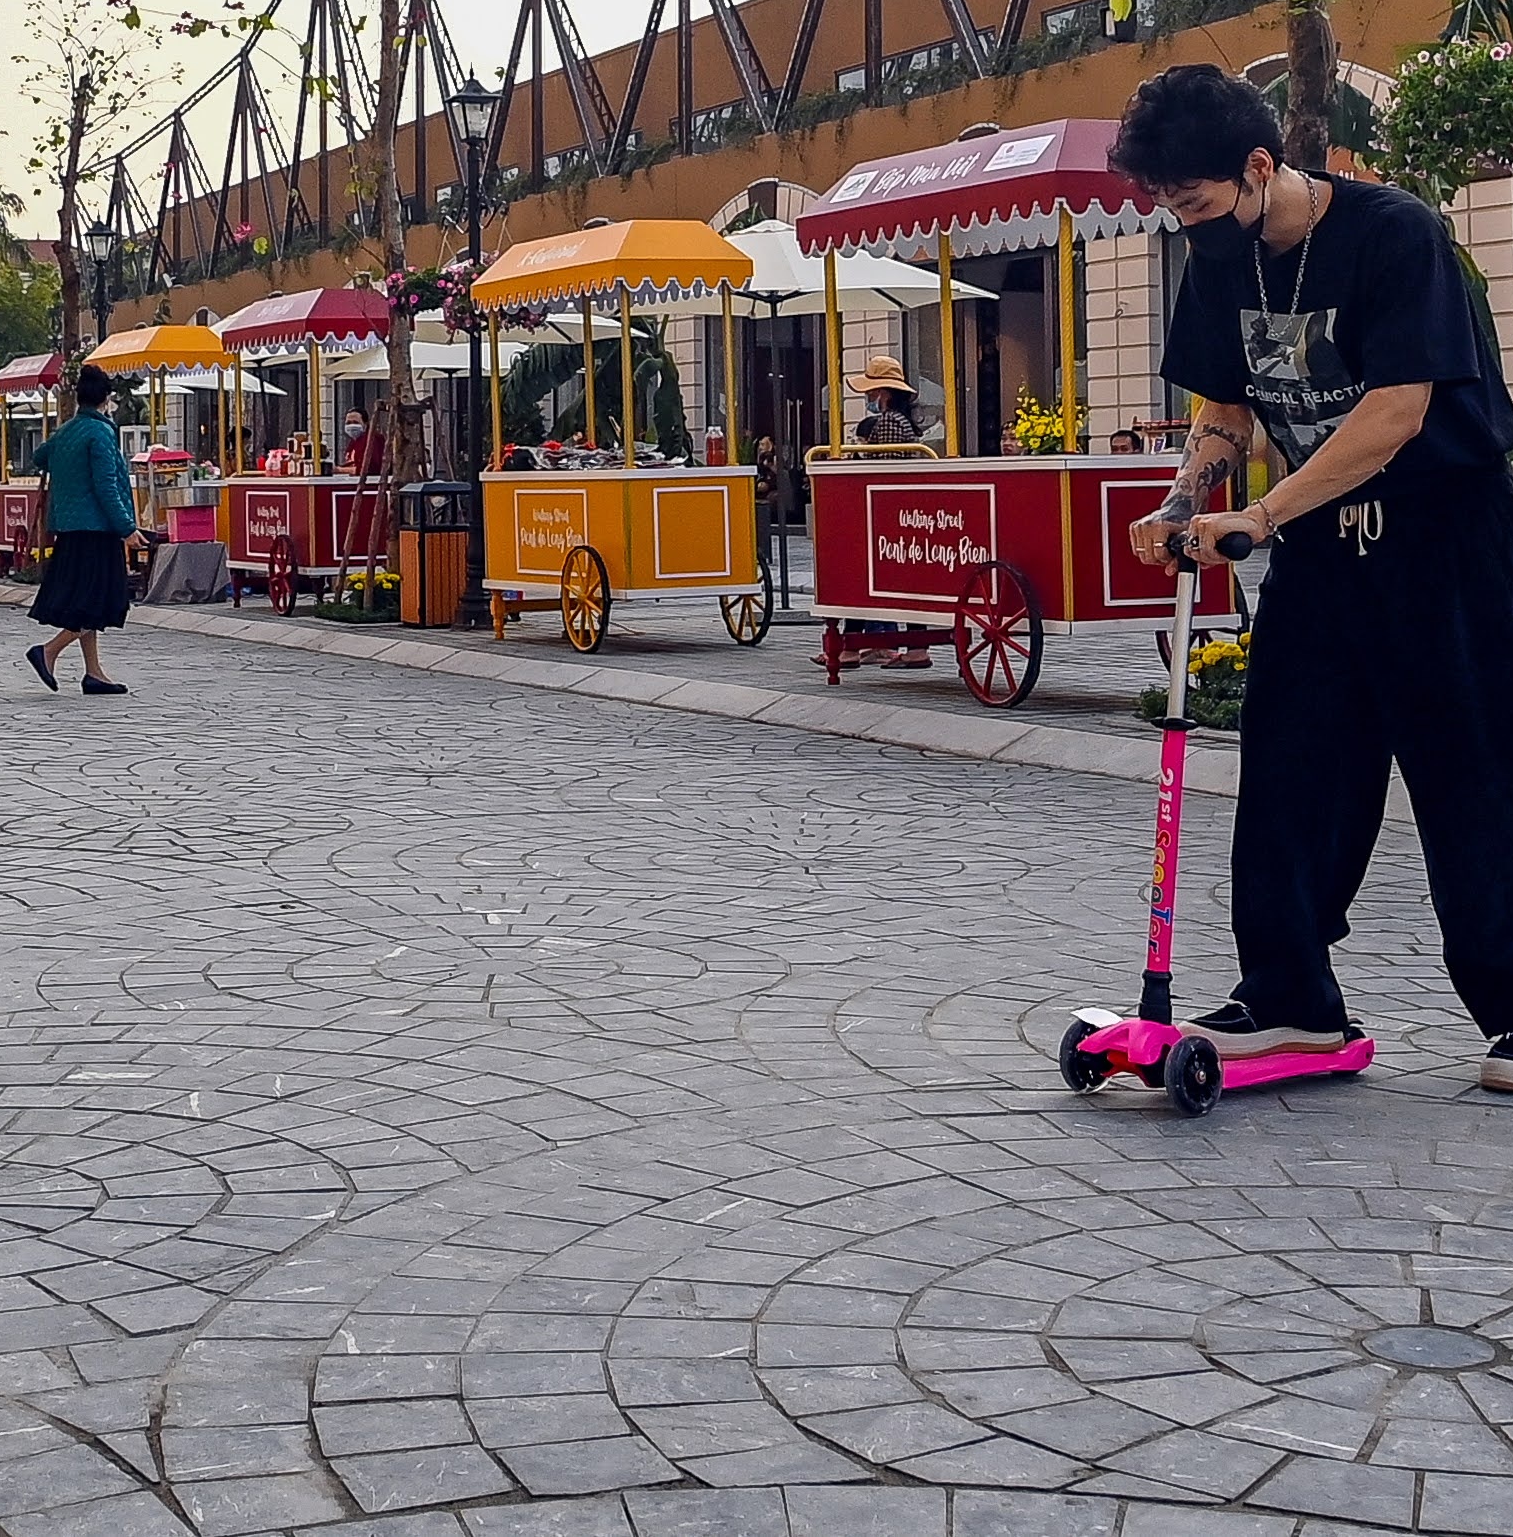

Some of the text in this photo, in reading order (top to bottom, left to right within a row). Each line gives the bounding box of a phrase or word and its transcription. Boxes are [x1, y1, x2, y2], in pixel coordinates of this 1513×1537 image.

[878, 535, 990, 573] Pont de Long Bien
[1158, 767, 1175, 823] 21st
